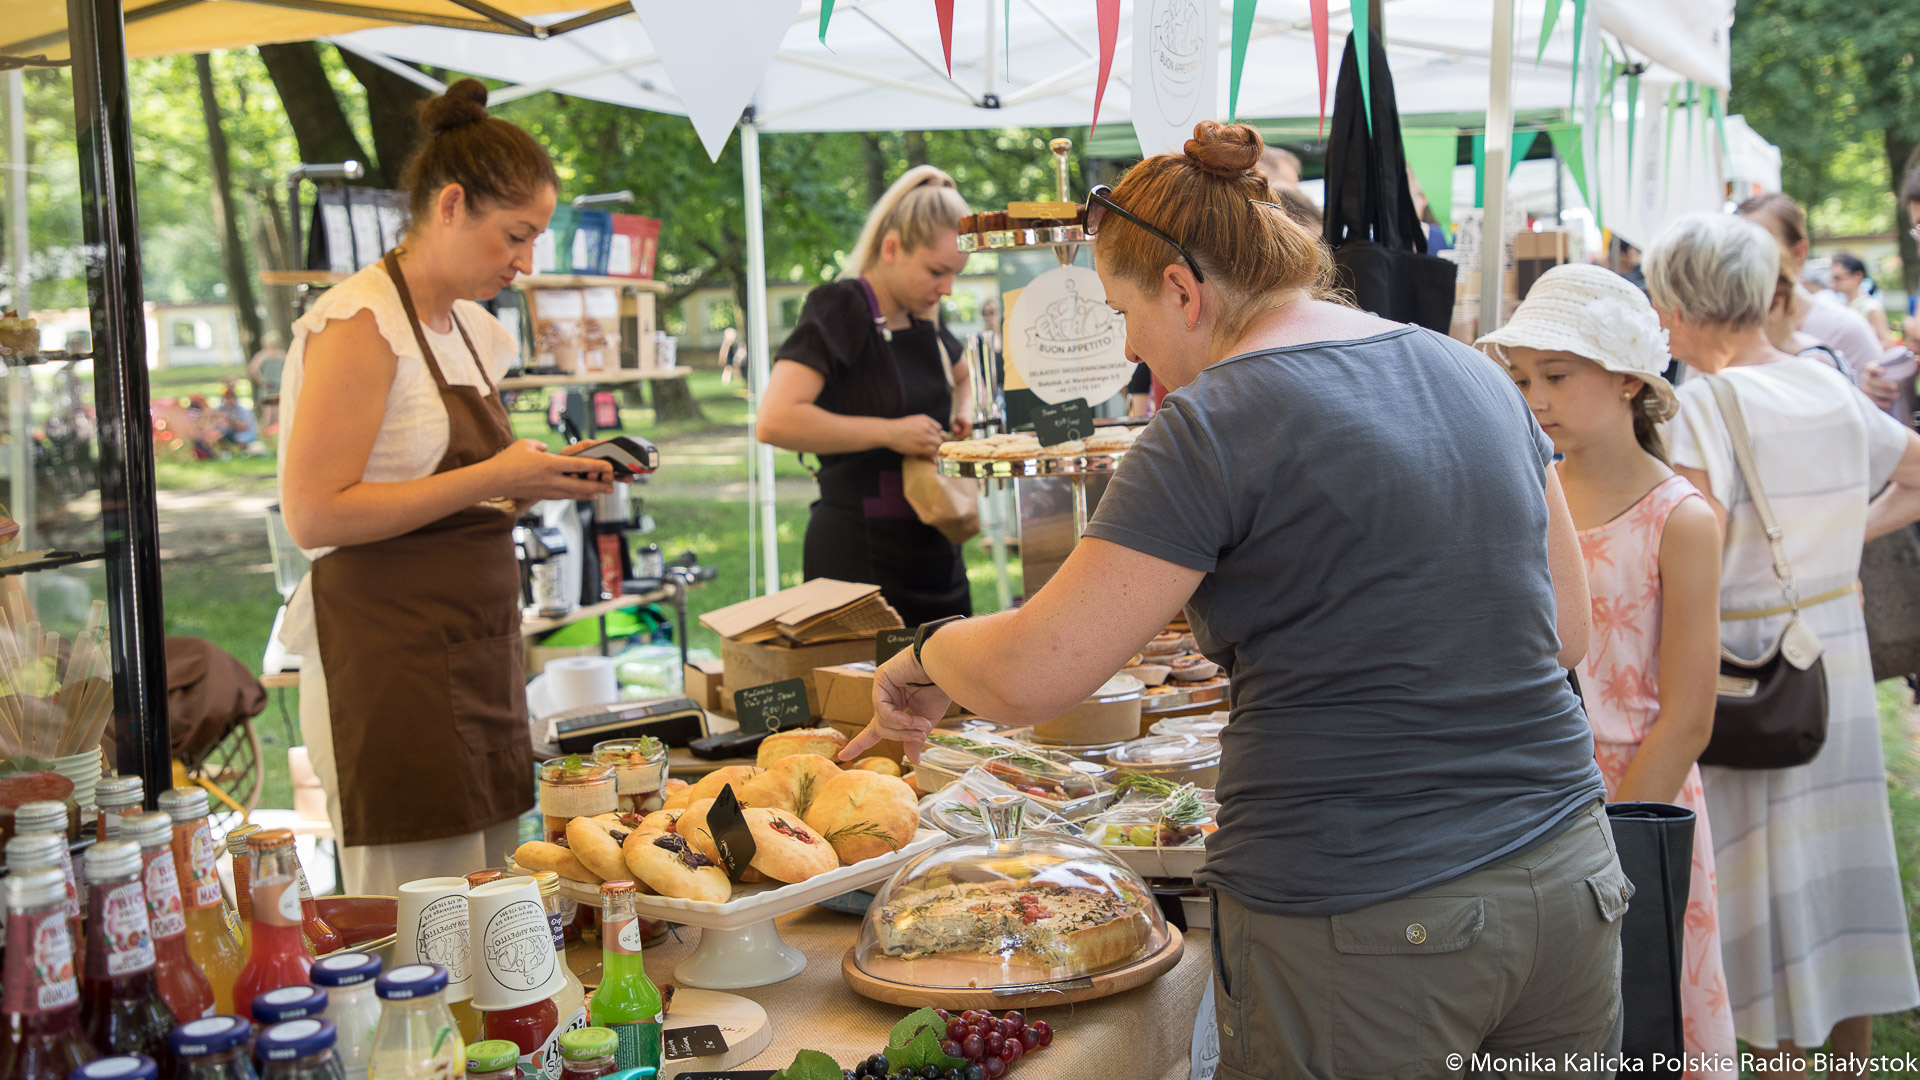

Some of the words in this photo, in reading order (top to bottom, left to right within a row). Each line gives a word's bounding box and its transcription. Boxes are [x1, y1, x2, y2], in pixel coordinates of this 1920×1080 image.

[1039, 343, 1065, 354] BUON
[1067, 336, 1112, 353] APPETITO
[424, 920, 457, 939] APPETITO
[494, 928, 528, 947] APPETITO
[529, 925, 545, 934] BUON
